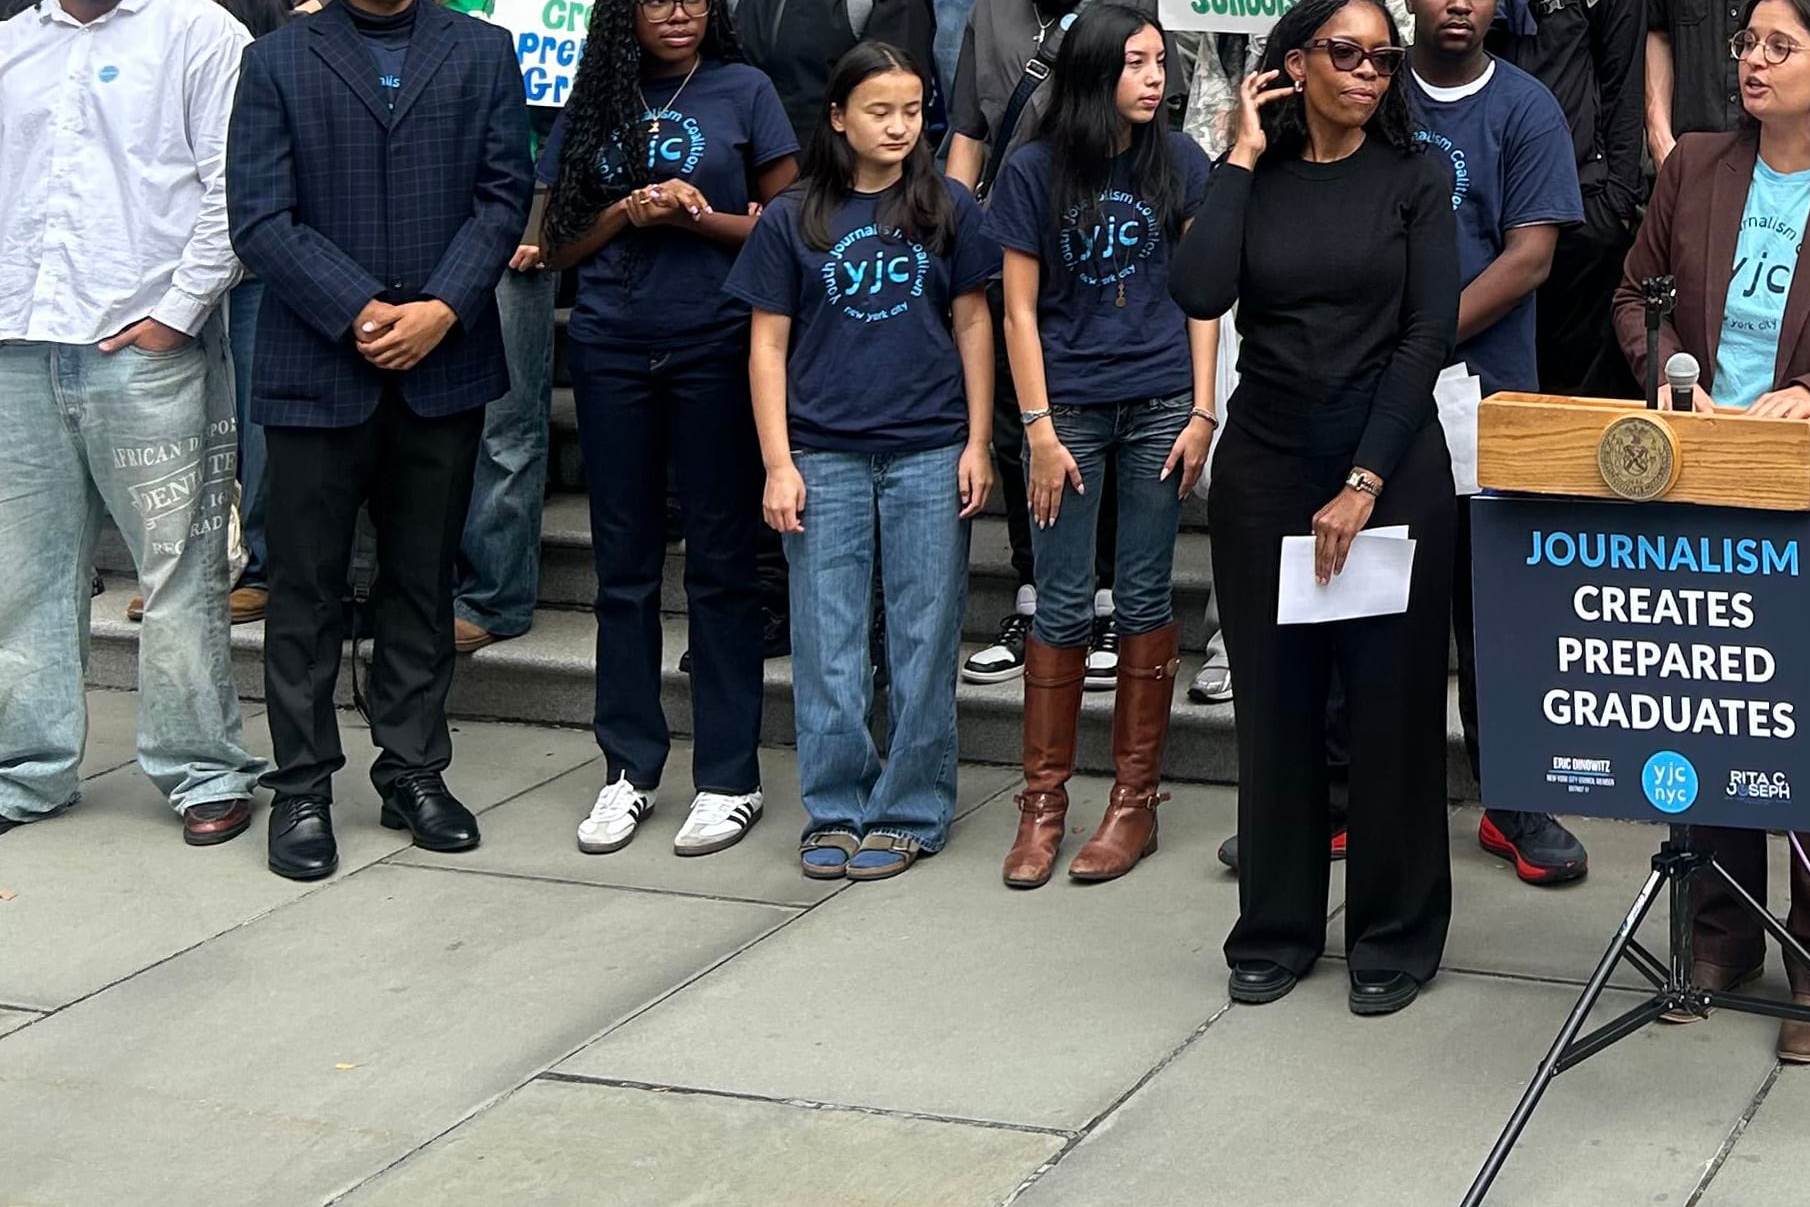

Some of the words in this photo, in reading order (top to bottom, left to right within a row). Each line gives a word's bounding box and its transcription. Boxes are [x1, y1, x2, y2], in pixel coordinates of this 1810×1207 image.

[843, 251, 910, 295] yjc
[1730, 318, 1757, 330] york
[1758, 318, 1778, 331] city
[111, 441, 183, 470] AFRICAN
[1525, 529, 1800, 576] JOURNALISM
[1572, 585, 1755, 629] CREATES
[1557, 637, 1776, 683] PREPARED
[1542, 688, 1797, 739] GRADUATES
[1654, 764, 1687, 787] yjc
[1730, 770, 1770, 786] RITA
[1655, 785, 1688, 805] nyc
[1726, 782, 1790, 800] JOSEPH
